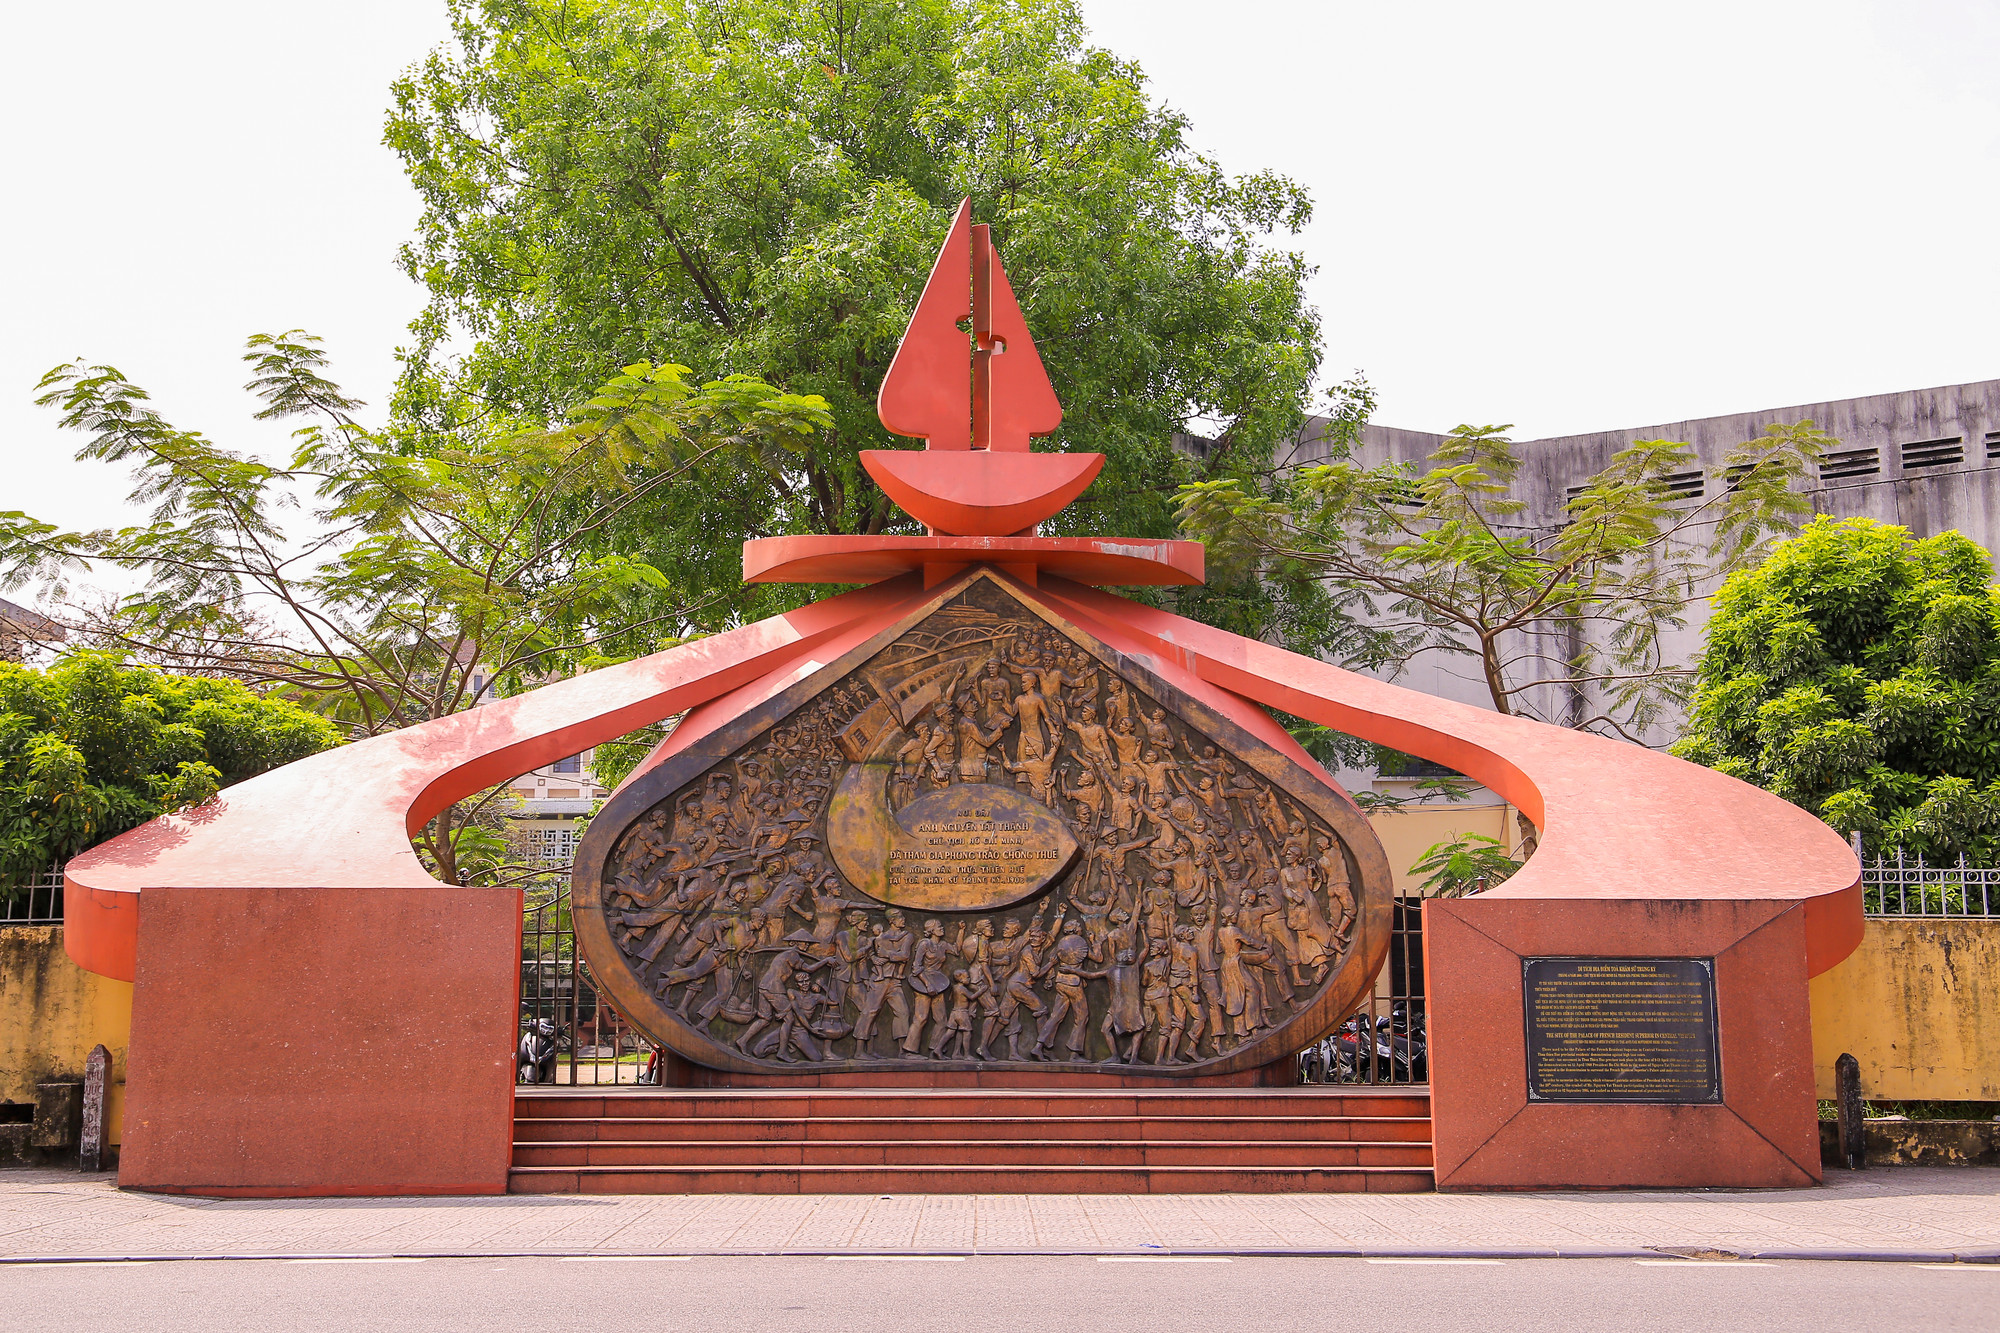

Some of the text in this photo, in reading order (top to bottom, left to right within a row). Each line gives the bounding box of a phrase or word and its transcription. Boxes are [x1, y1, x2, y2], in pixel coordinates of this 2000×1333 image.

[919, 824, 938, 832] ANH
[903, 851, 926, 860] THAM
[928, 851, 945, 860] GIA
[945, 851, 976, 860] PHONG
